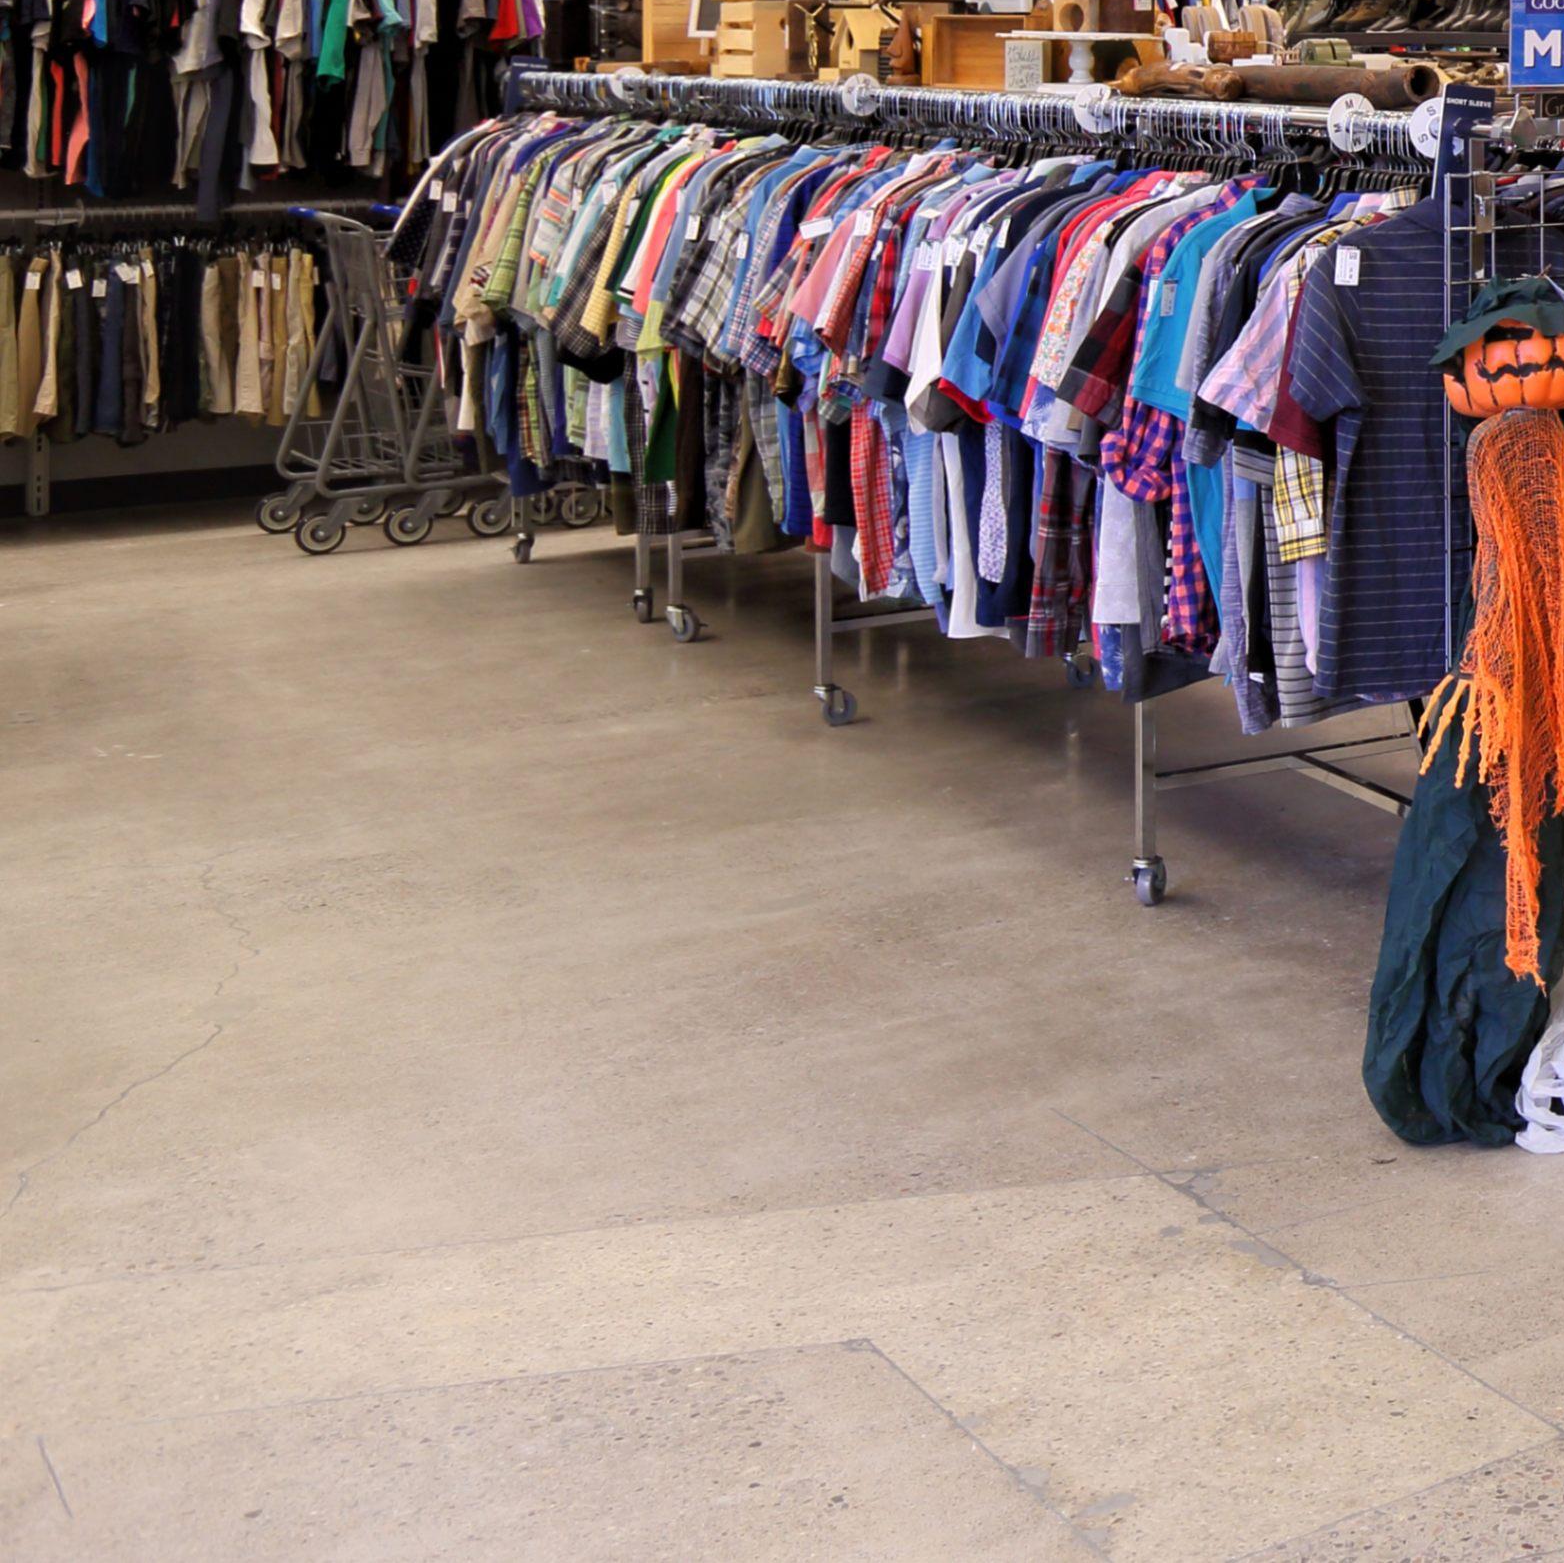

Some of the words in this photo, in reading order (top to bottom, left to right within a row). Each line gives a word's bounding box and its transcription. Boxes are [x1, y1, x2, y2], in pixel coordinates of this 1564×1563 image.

[1345, 99, 1354, 109] M
[1446, 97, 1468, 106] SHORT
[1468, 99, 1492, 108] SLEEVE
[1426, 106, 1437, 116] S
[1418, 133, 1429, 143] S
